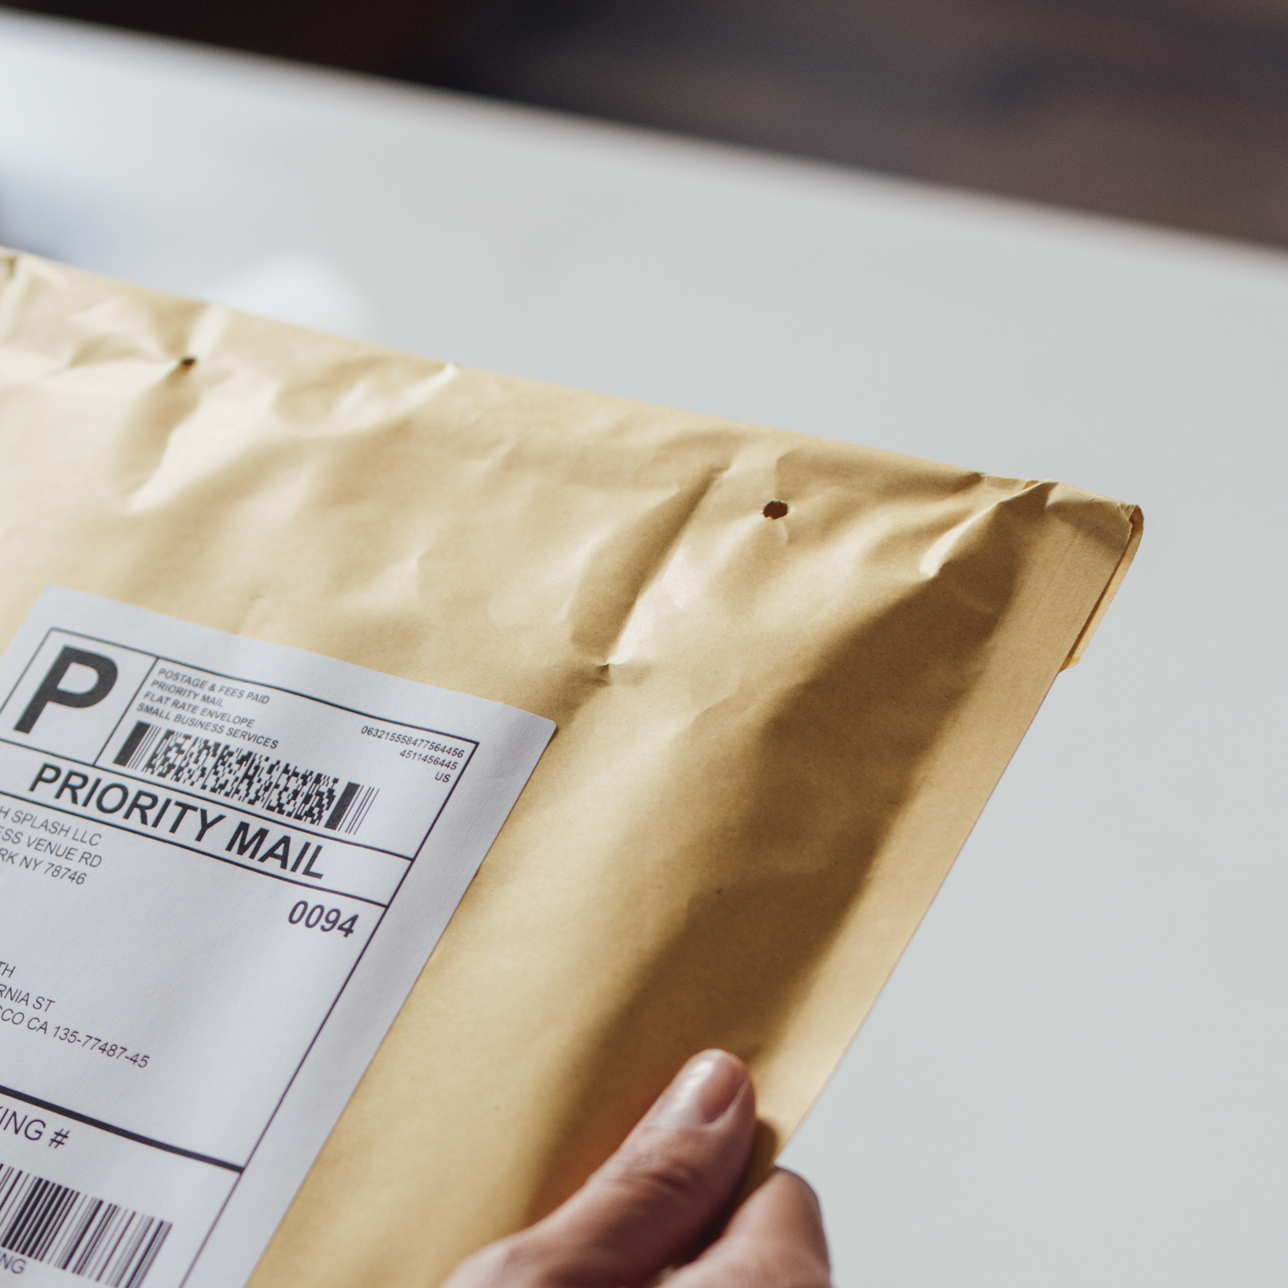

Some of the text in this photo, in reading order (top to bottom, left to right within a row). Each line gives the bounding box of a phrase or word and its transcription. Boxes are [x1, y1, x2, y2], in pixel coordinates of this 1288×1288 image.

[13, 646, 119, 734] P
[151, 679, 223, 707] PRIORITY MAIL
[158, 668, 270, 704] POSTAGE & FEES PAID
[137, 703, 279, 749] SMALL BUSINESS SERVICES
[144, 691, 255, 728] FLAT RATE ENVELOPE
[400, 749, 458, 770] 4511456445
[435, 772, 450, 783] US
[12, 810, 71, 838] SPLASH
[72, 828, 101, 846] LLC
[29, 763, 324, 880] PRIORITY MAIL
[26, 835, 78, 861] VENUE
[78, 851, 102, 868] RD
[19, 855, 43, 871] NY
[44, 862, 87, 885] 78746
[288, 900, 360, 939] 0094
[32, 996, 55, 1013] ST
[27, 1017, 49, 1034] CA
[53, 1025, 150, 1069] 135-77487-45
[48, 1126, 71, 1151] #
